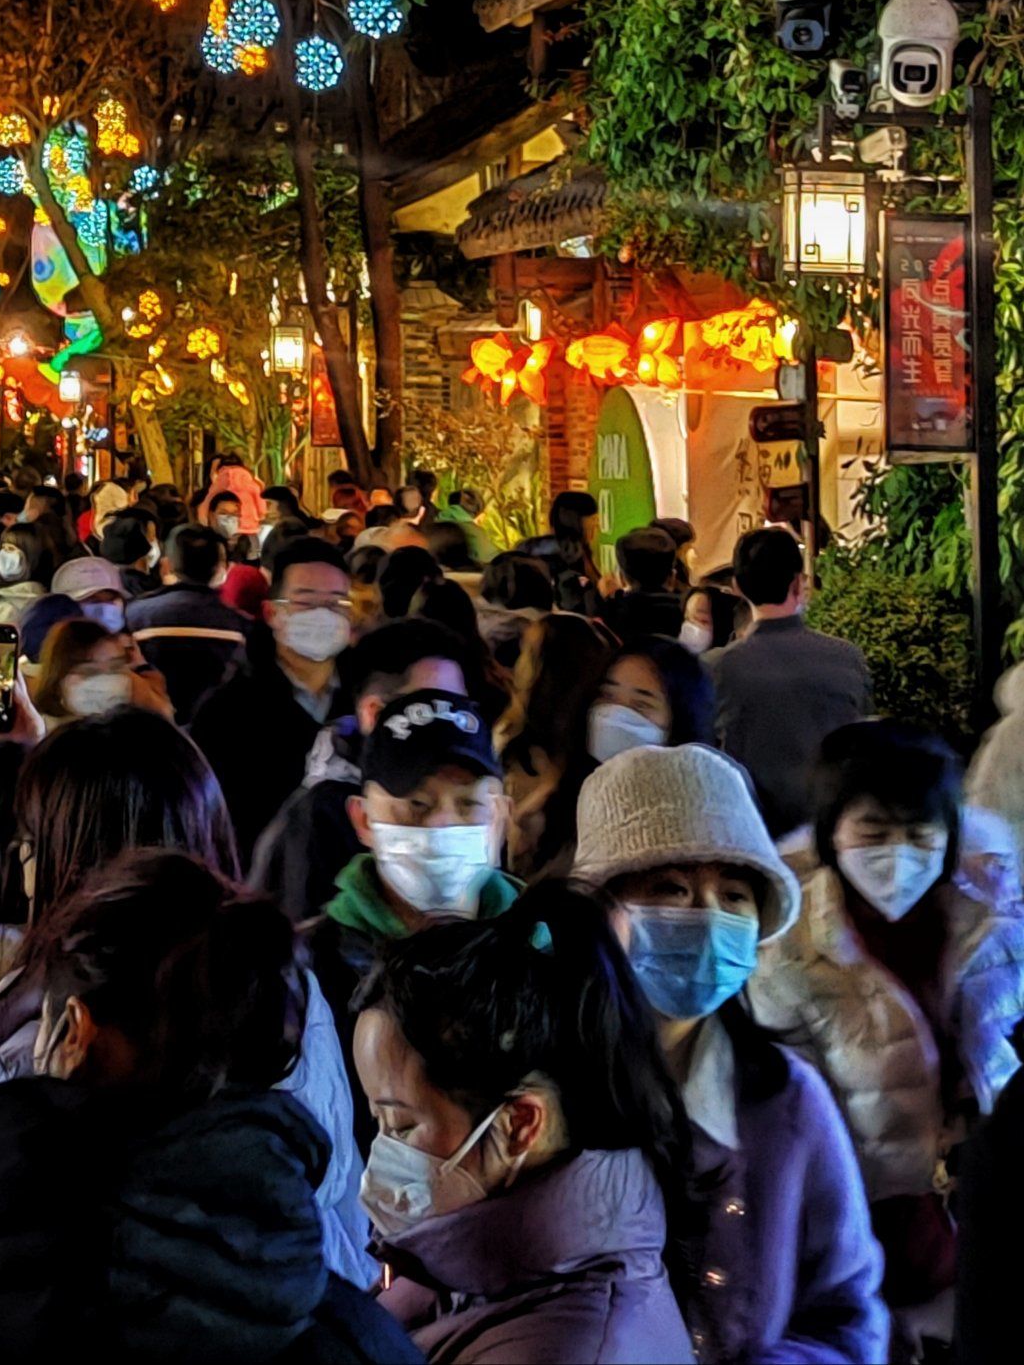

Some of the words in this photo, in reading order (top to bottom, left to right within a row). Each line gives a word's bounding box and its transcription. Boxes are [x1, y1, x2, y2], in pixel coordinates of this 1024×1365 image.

[900, 258, 951, 273] 2023
[901, 278, 923, 384] 同光而生
[383, 699, 480, 741] POLO
